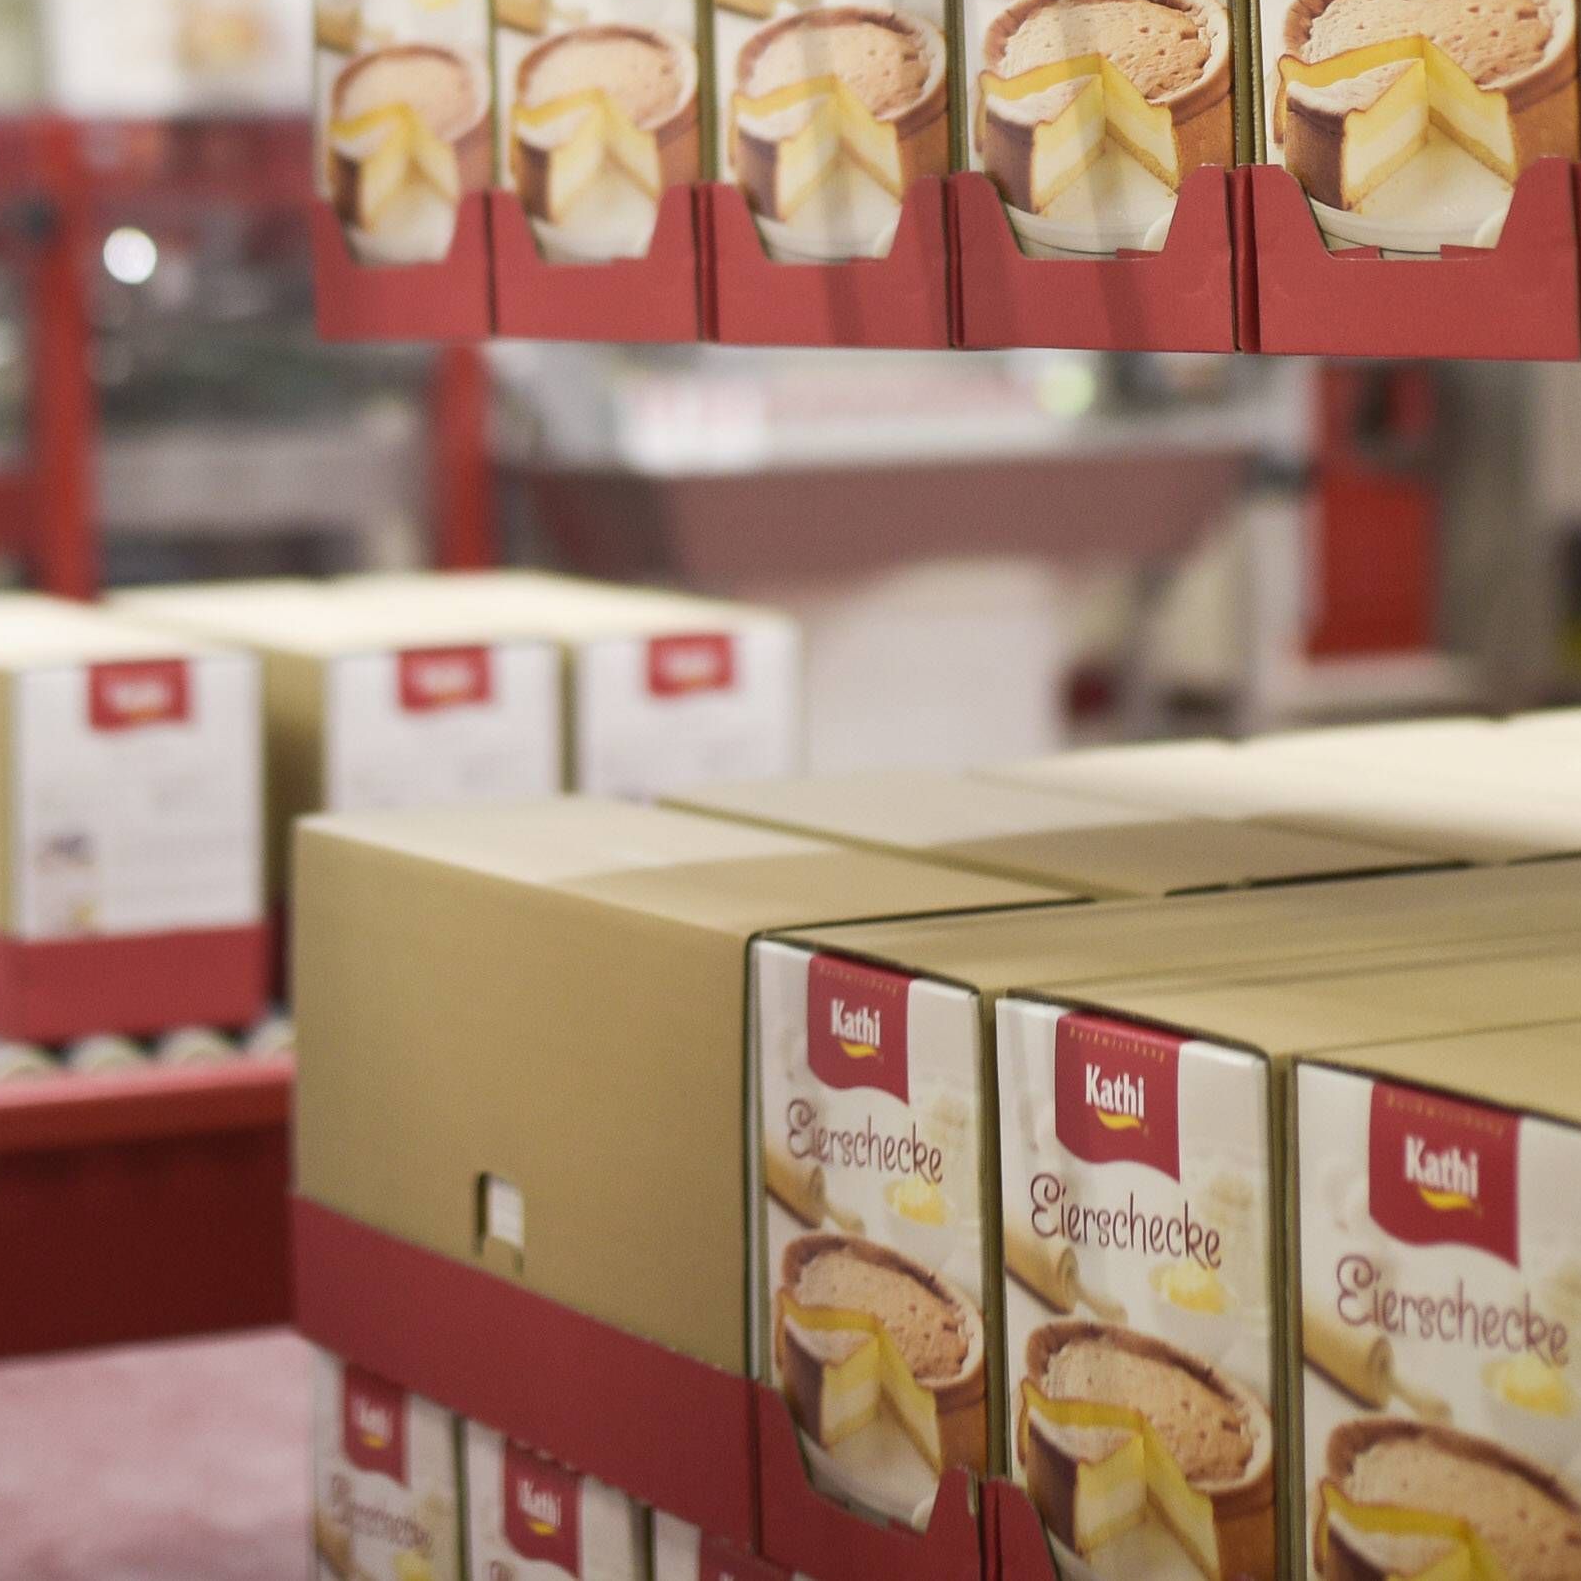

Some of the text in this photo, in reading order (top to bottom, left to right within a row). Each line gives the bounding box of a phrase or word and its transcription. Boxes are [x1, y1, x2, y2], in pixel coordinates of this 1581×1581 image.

[830, 998, 881, 1048] Kathi
[1085, 1062, 1145, 1119] Kathi
[786, 1098, 944, 1185] Eierschecke
[1403, 1133, 1479, 1199] Kathi
[1030, 1172, 1222, 1271] Eierschecke
[1335, 1252, 1570, 1369] Eierschecke
